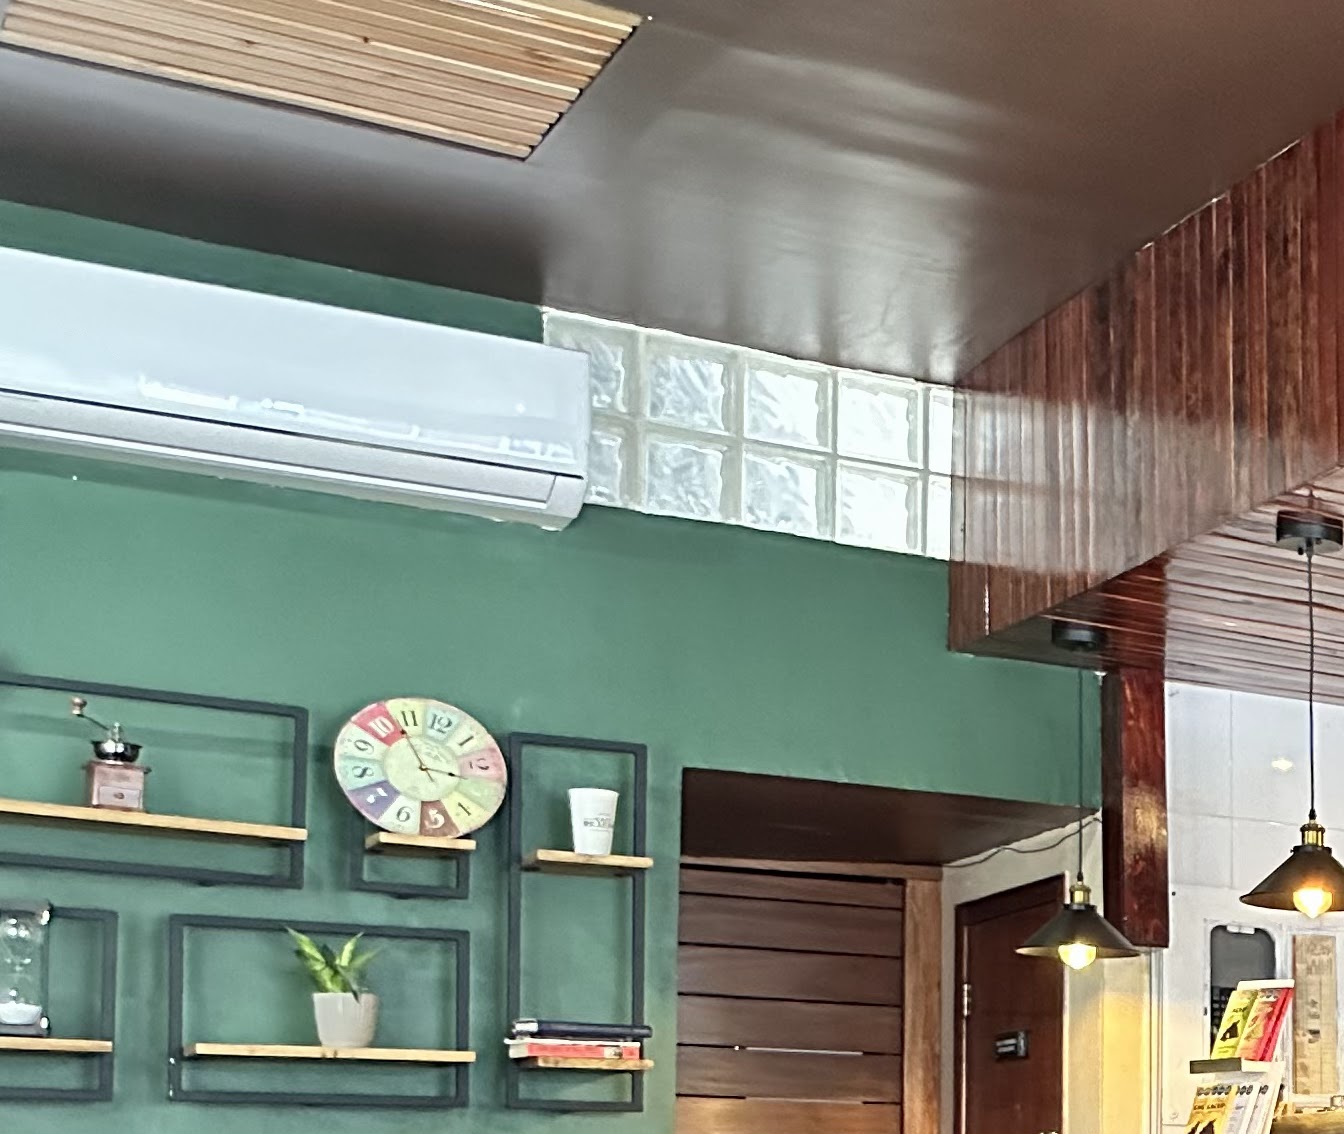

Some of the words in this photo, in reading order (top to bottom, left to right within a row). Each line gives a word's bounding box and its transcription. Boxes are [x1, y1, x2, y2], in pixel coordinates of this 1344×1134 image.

[368, 716, 395, 737] 10
[401, 710, 419, 727] 11
[429, 713, 453, 734] 12
[351, 765, 375, 779] 8
[396, 805, 414, 823] 6
[425, 808, 445, 829] 5
